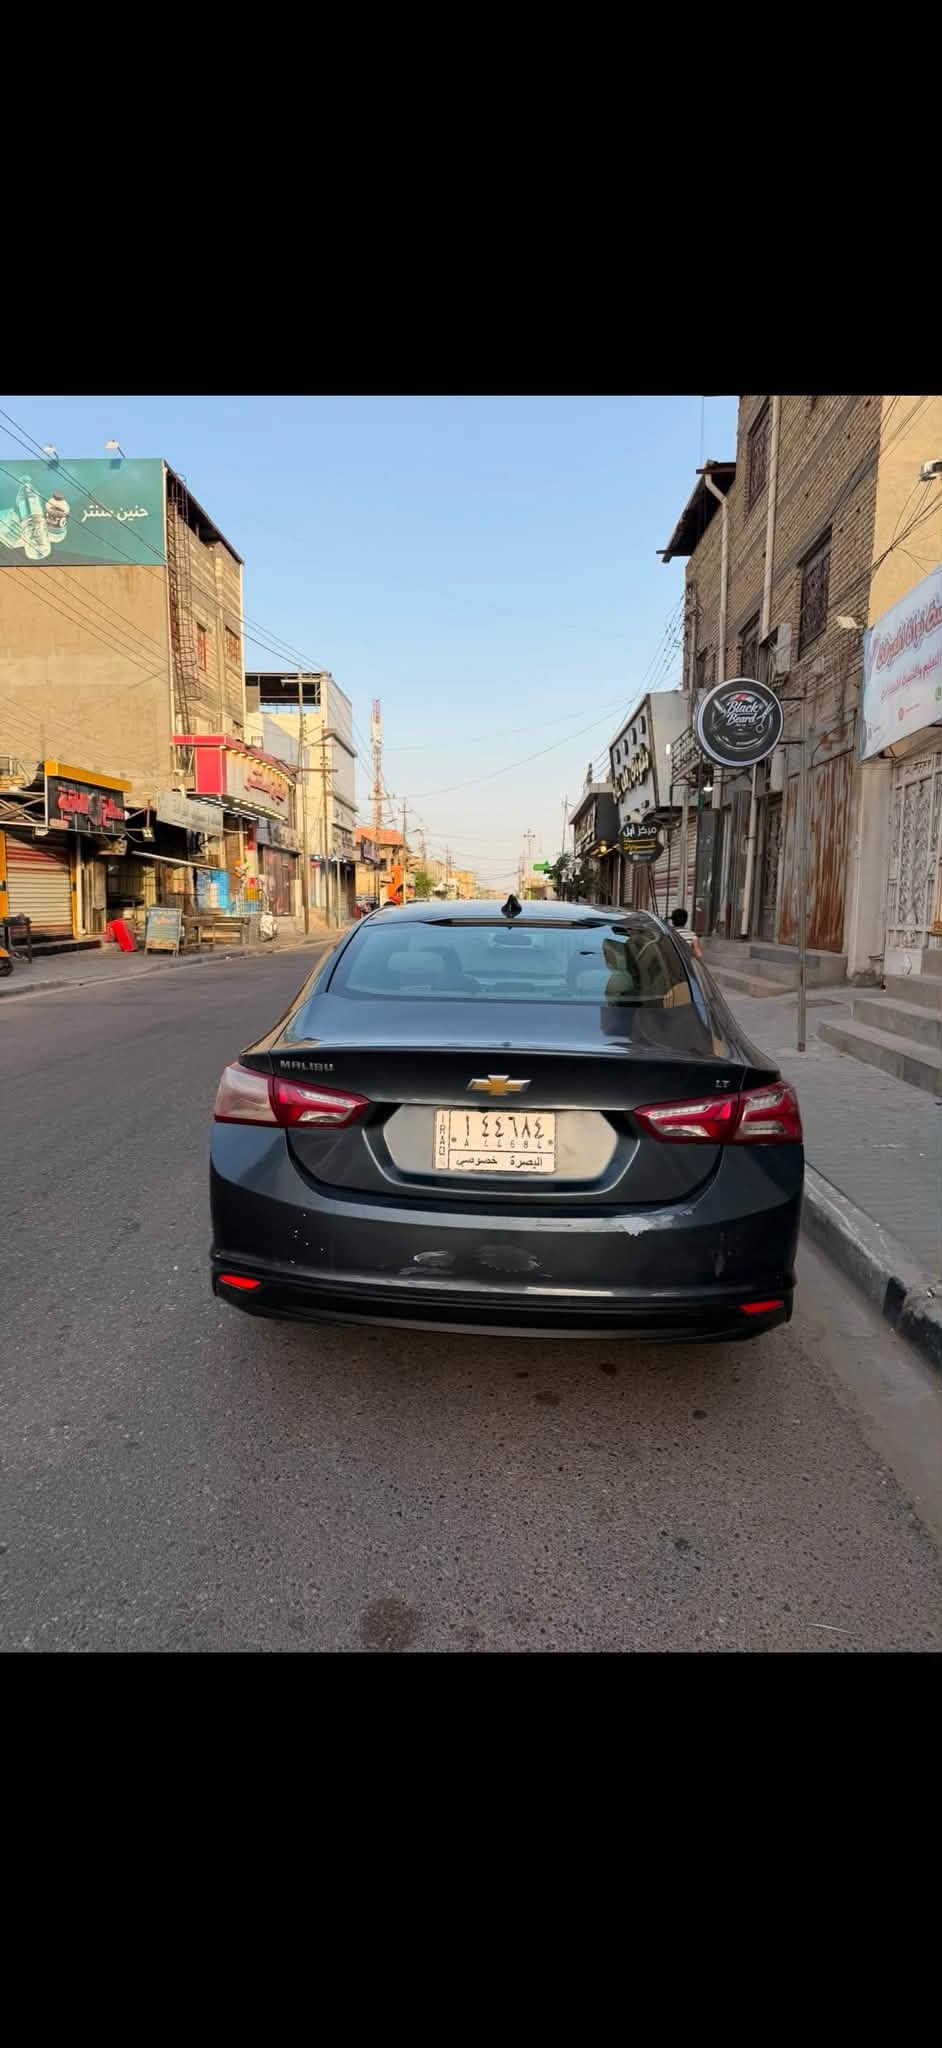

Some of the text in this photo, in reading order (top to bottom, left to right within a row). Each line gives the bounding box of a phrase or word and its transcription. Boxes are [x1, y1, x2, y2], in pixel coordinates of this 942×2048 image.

[116, 504, 149, 521] حنين
[726, 701, 759, 714] Black
[726, 713, 757, 726] Beard
[638, 826, 657, 837] مركز
[279, 1059, 334, 1072] MALIBU
[715, 1079, 730, 1088] LT
[438, 1113, 446, 1156] IRAQ
[455, 1154, 543, 1170] البصرة خصوصي
